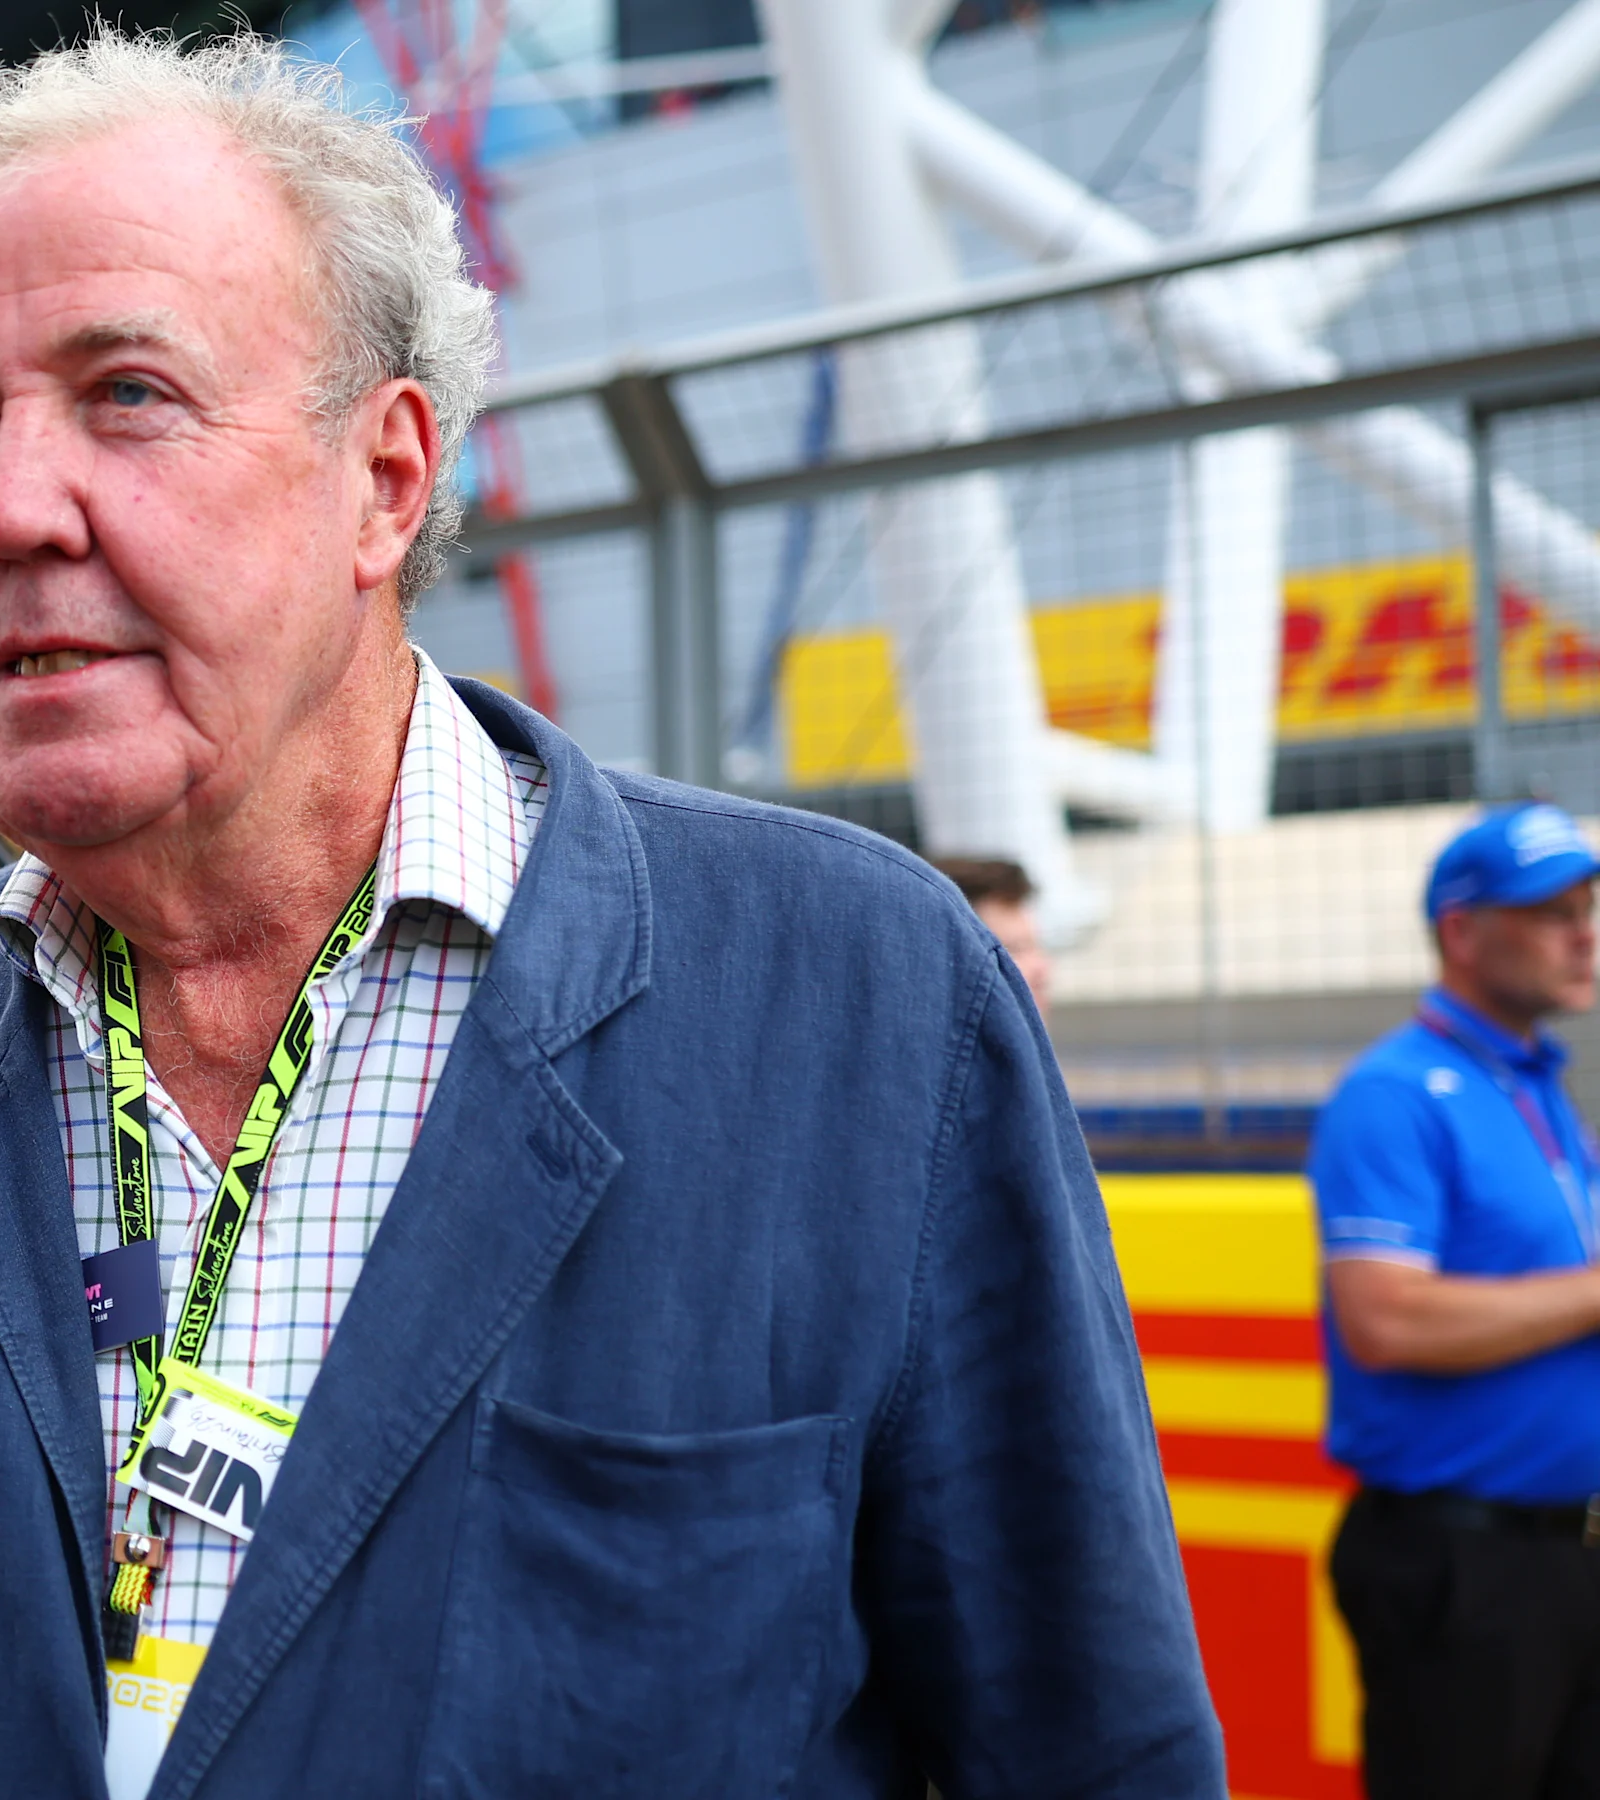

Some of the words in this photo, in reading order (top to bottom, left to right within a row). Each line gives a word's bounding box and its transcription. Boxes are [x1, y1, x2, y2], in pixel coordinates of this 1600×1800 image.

[107, 1026, 148, 1120] VIP
[229, 1082, 283, 1174] VIP
[121, 1157, 147, 1237] Silverstone
[176, 1303, 209, 1364] TAIN
[196, 1220, 234, 1299] Silverstone
[139, 1438, 262, 1530] VIP
[106, 1675, 189, 1718] 026
